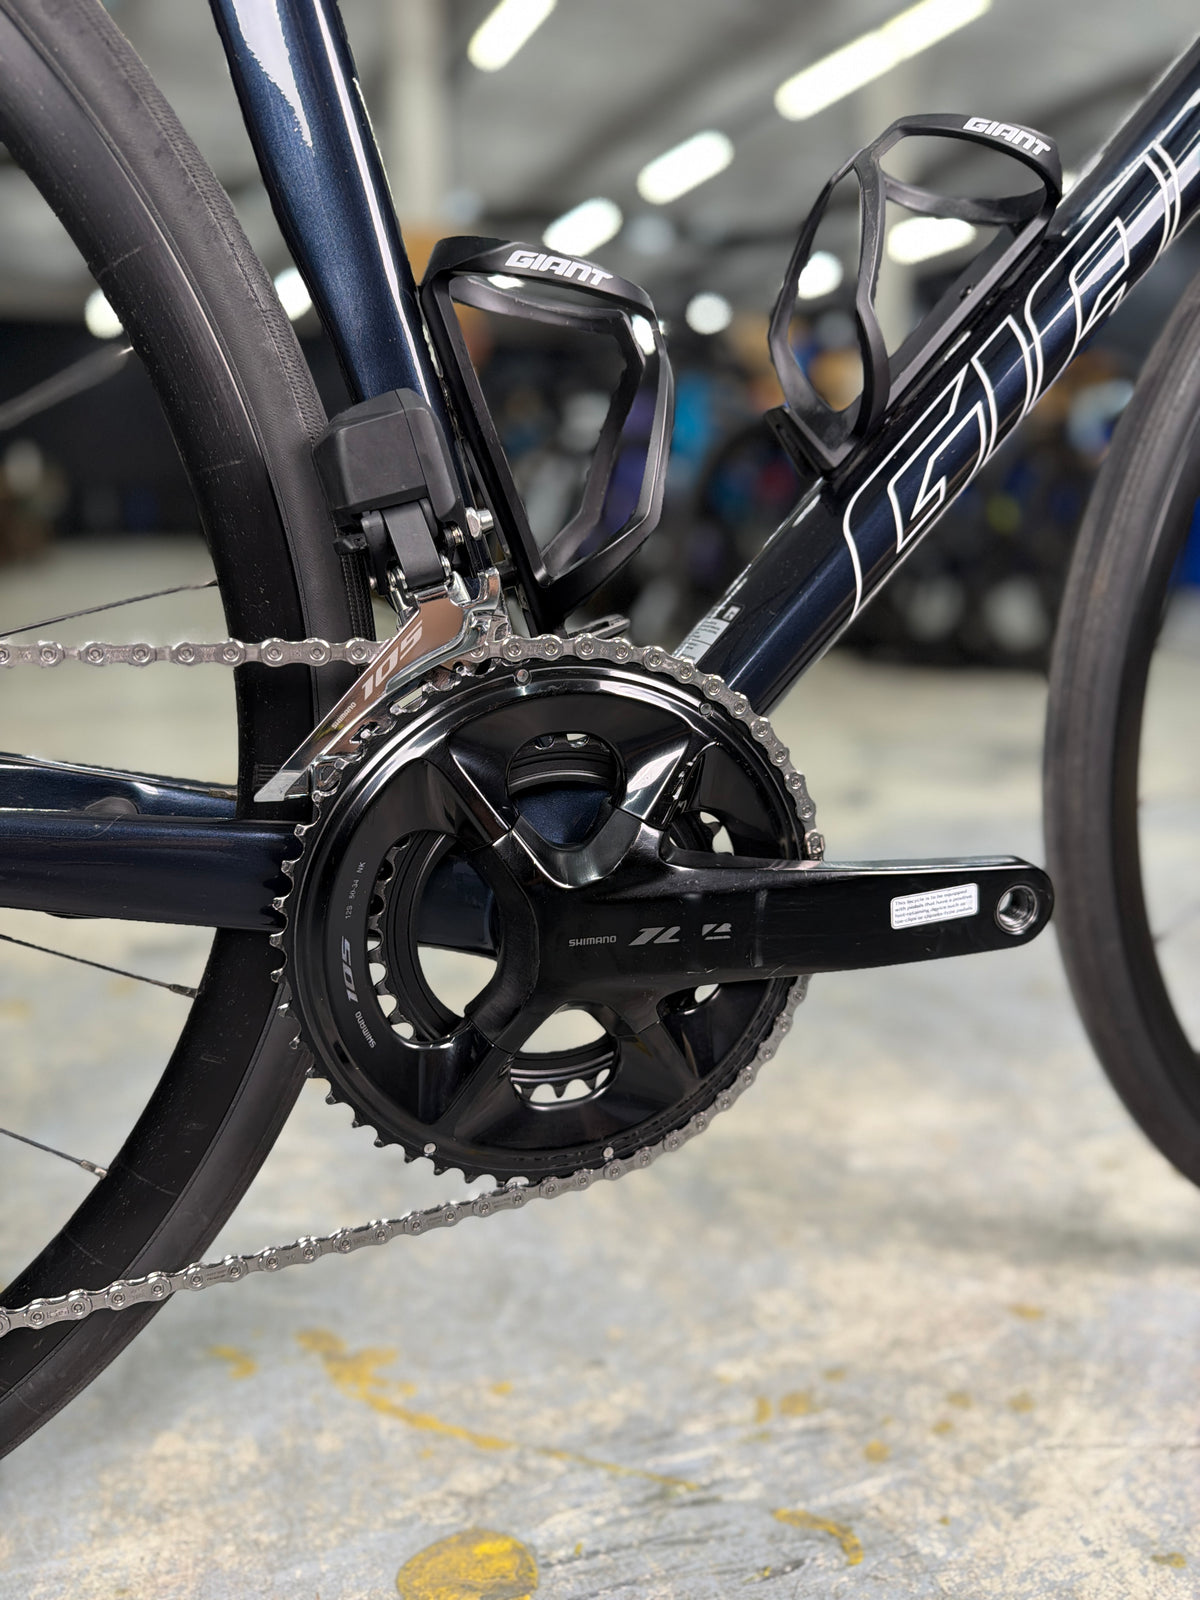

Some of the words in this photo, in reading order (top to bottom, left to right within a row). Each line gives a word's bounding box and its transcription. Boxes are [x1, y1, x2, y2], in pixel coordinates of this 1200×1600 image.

[962, 116, 1052, 156] GIANT
[504, 249, 614, 286] GIANT
[331, 701, 357, 729] SHIMANO
[361, 619, 423, 701] 105
[568, 934, 618, 948] SHIMANO
[341, 935, 359, 1004] 105
[354, 1010, 377, 1049] SHIMANO
